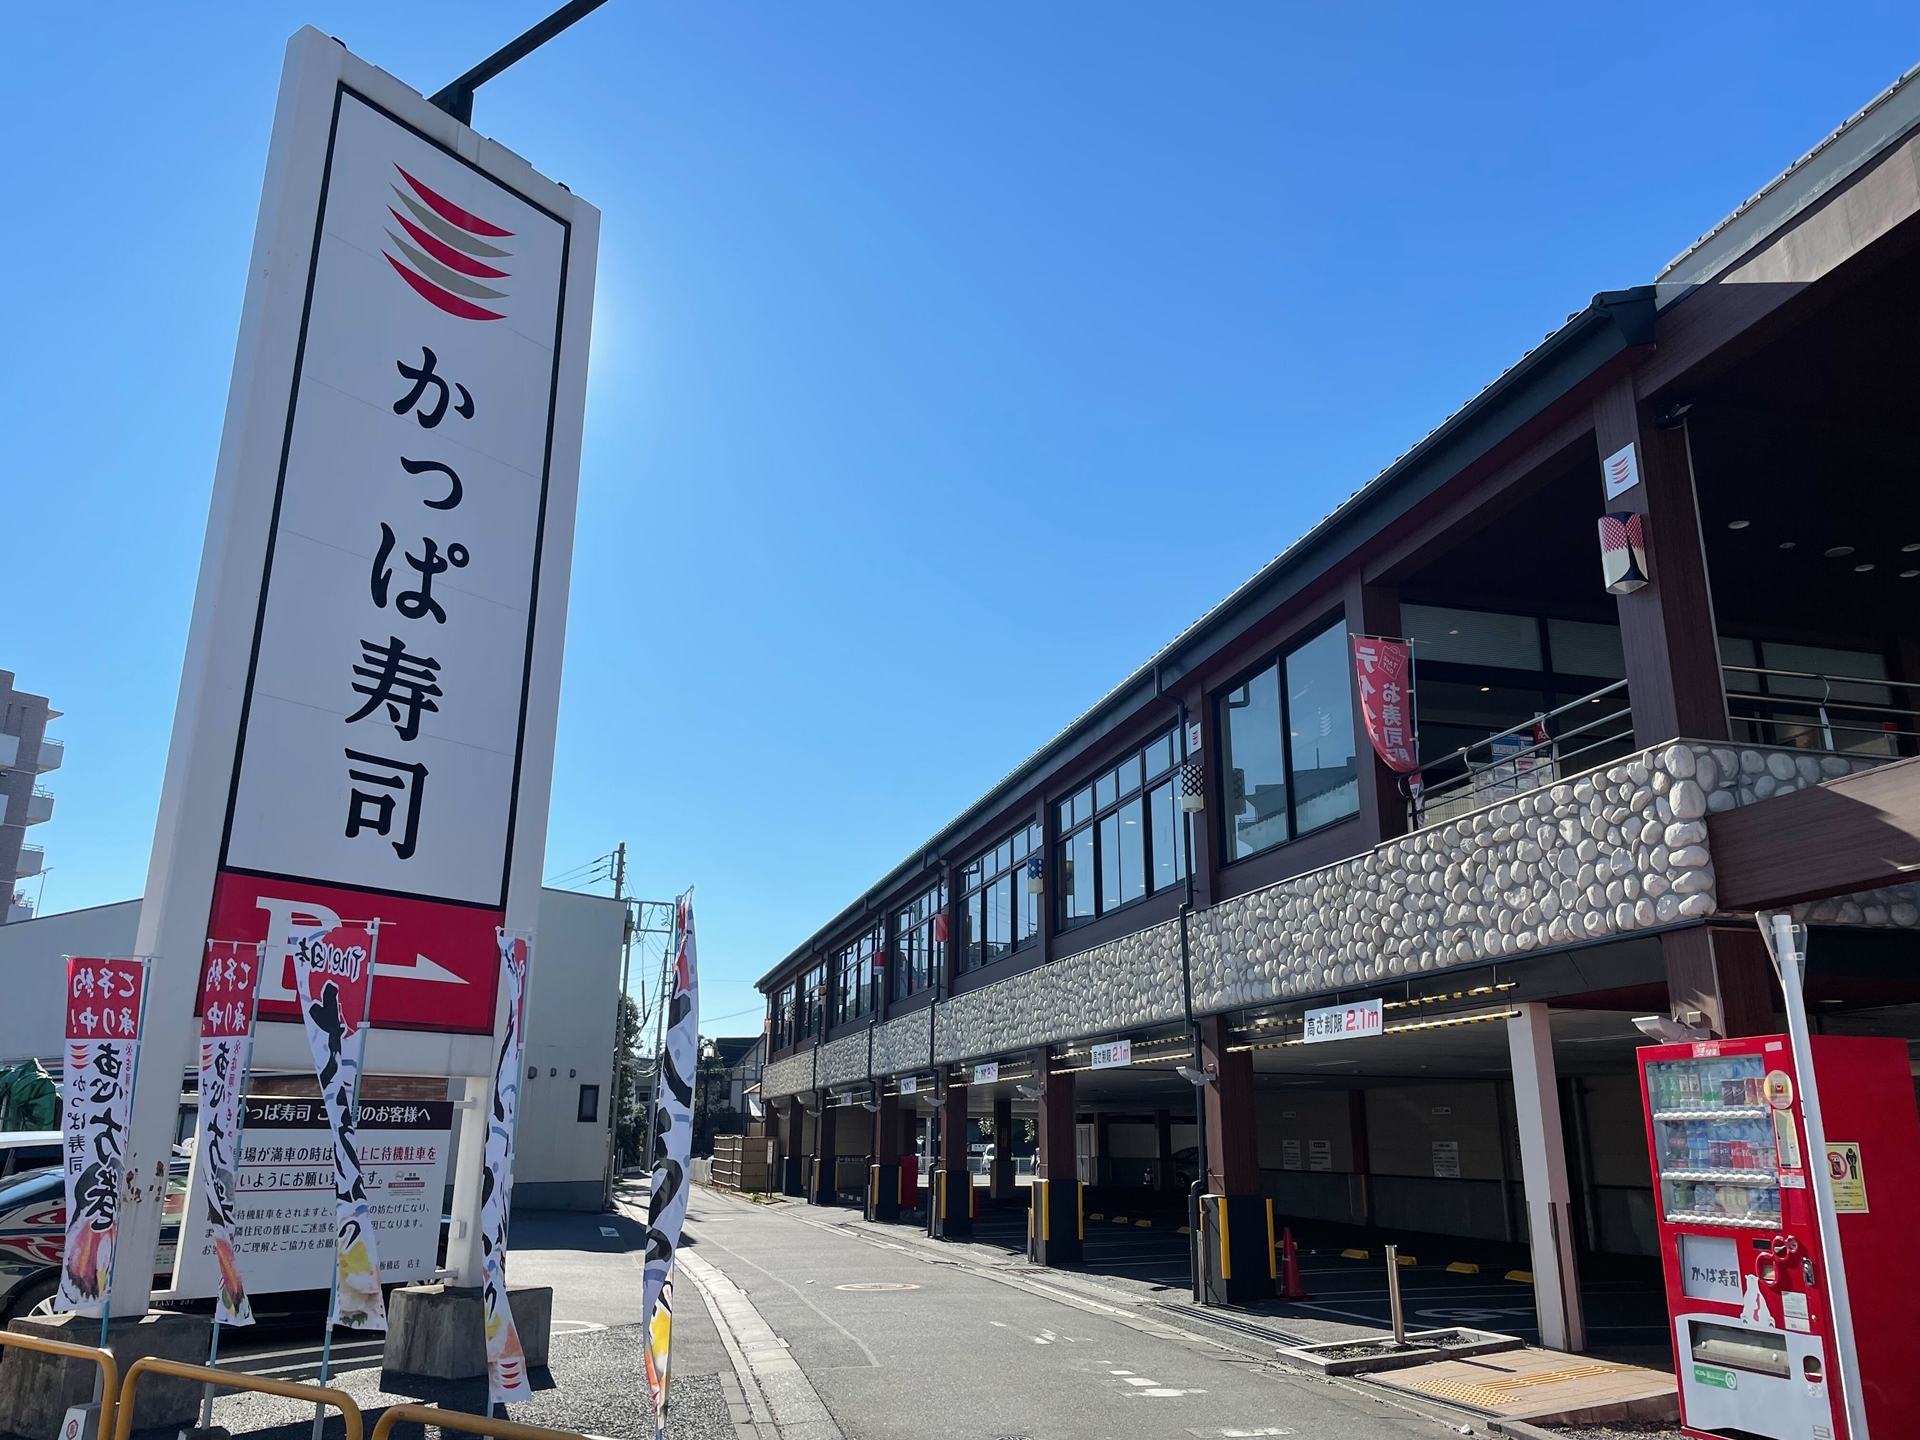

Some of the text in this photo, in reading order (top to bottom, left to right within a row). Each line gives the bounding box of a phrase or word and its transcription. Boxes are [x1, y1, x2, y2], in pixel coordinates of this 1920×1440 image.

[344, 345, 476, 859] かっぱ寿司
[253, 896, 343, 1002] P
[1307, 1008, 1379, 1037] 高さ制限 2.1m
[407, 1258, 421, 1269] 店主
